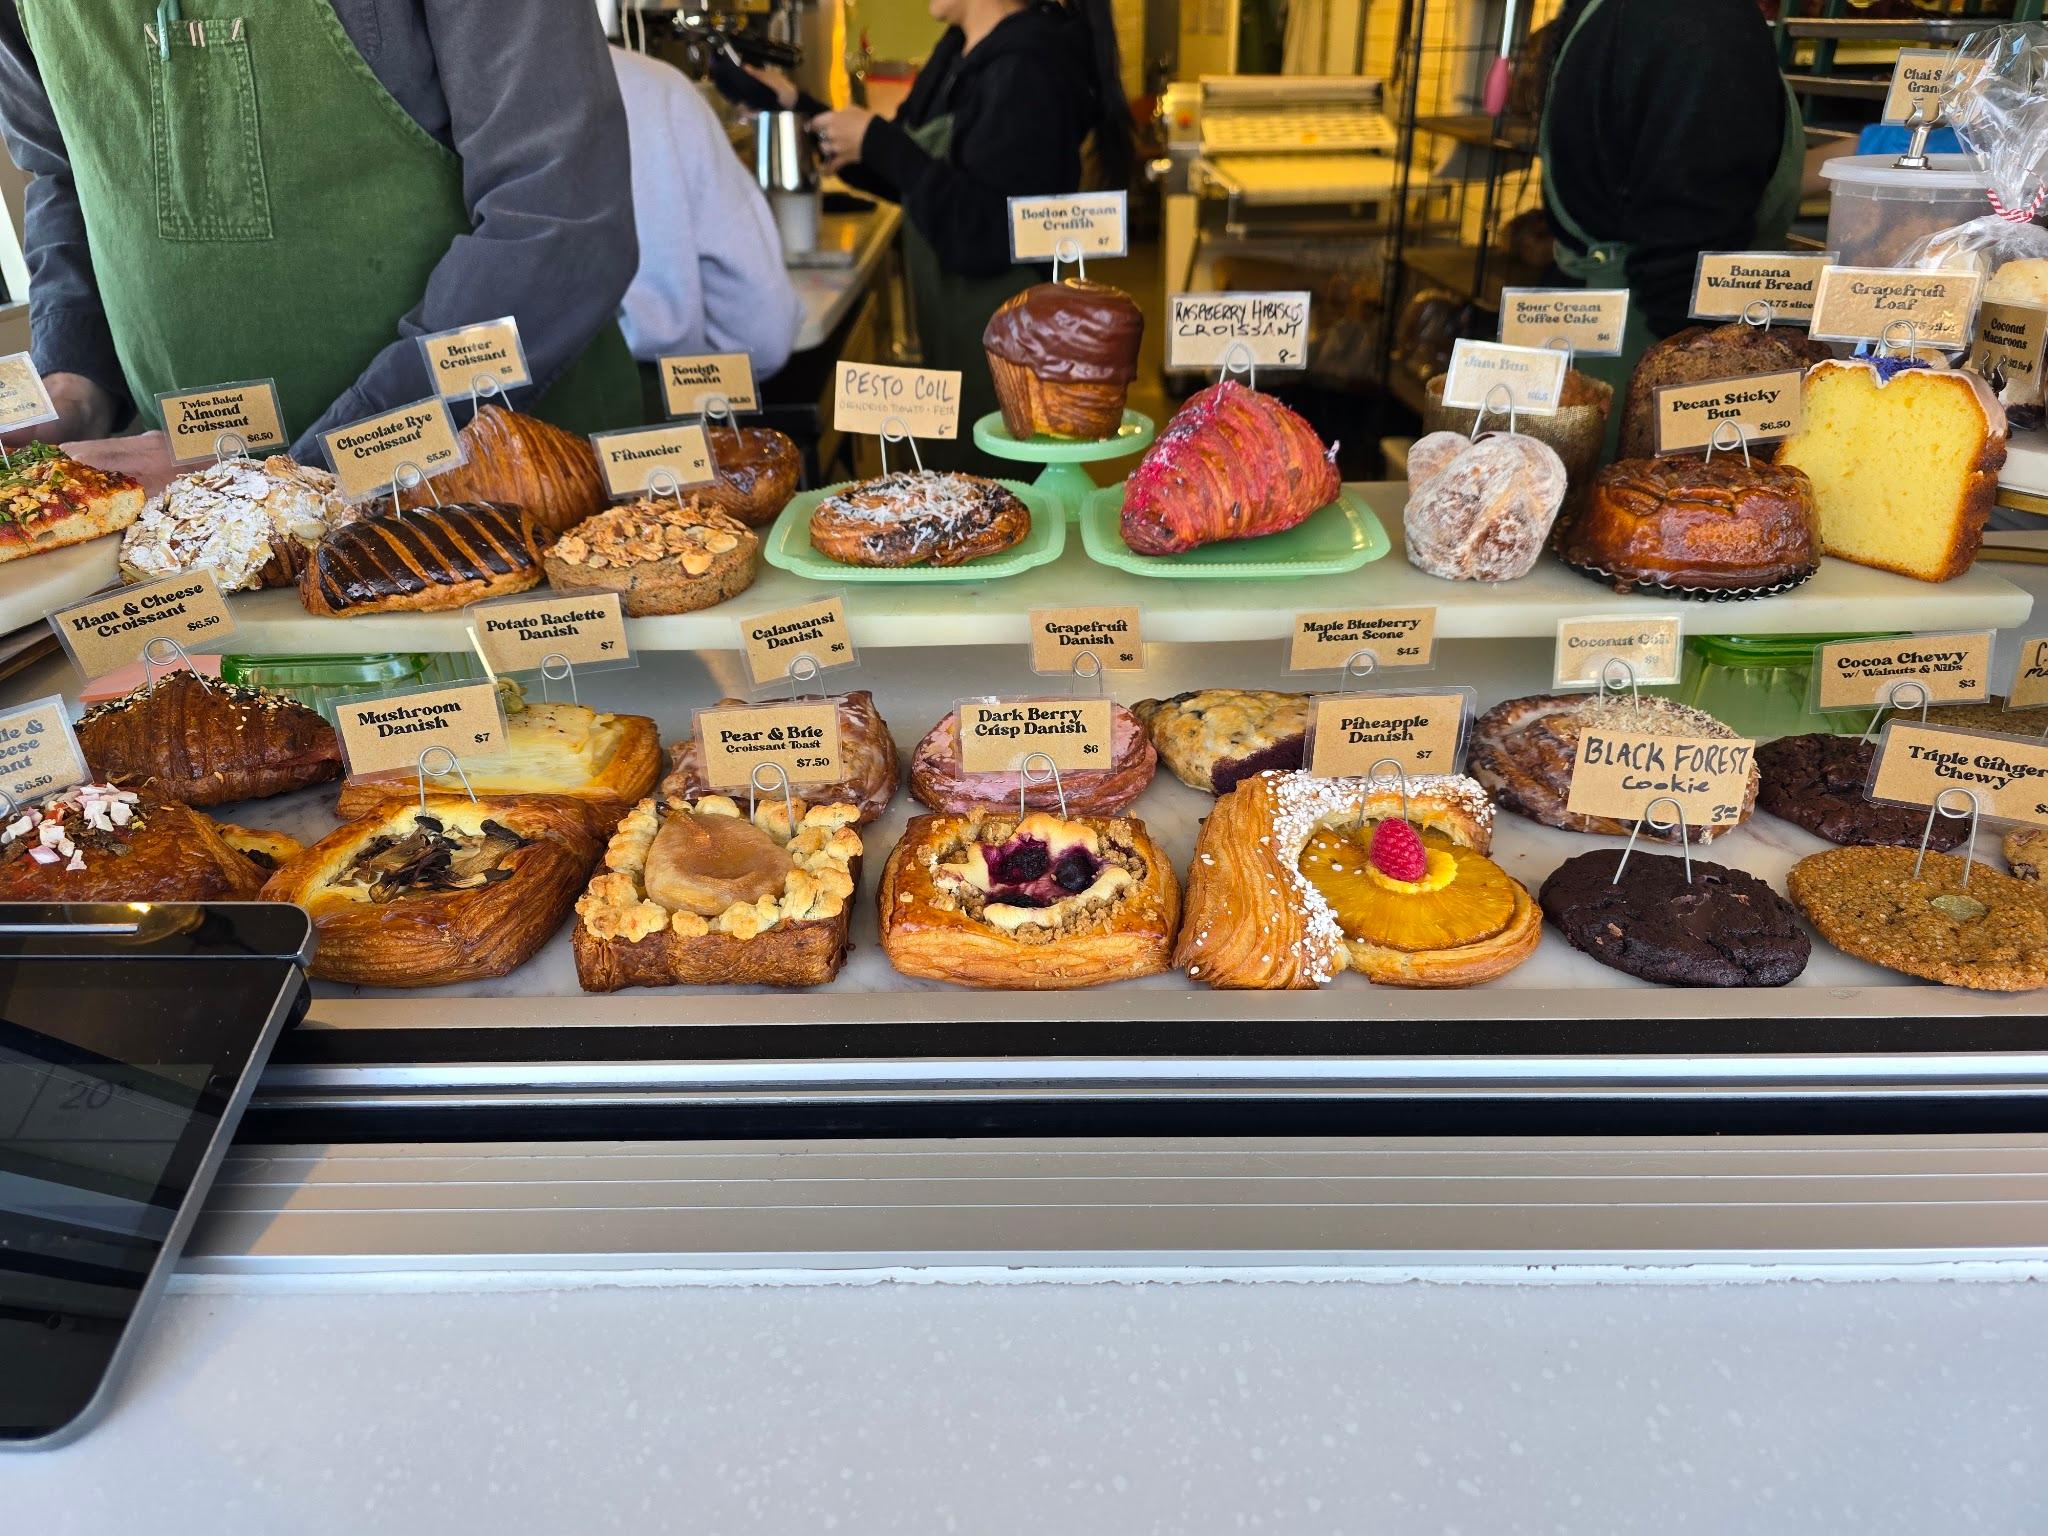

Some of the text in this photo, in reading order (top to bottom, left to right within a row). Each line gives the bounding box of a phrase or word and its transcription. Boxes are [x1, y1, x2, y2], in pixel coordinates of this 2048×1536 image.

[1904, 68, 1932, 80] Chai
[1908, 81, 1940, 93] Gran
[1022, 205, 1116, 219] Boston Cream
[1730, 265, 1791, 278] Banana
[1707, 276, 1813, 291] Walnut Bread
[1851, 282, 1946, 299] Grapefruit
[1517, 301, 1602, 313] Sour Cream
[1875, 297, 1917, 310] Loaf
[1176, 302, 1247, 325] RASPBERRY
[1517, 313, 1599, 324] Coffee Cake
[1179, 320, 1304, 338] CROISSANT
[1991, 318, 2026, 335] Coconut
[1983, 329, 2028, 350] Macaroons
[448, 341, 493, 357] Butter
[440, 349, 507, 370] Croissant
[672, 376, 722, 387] Amann
[846, 369, 954, 403] PESTO COIL
[179, 394, 244, 411] Twice Baked
[1672, 389, 1781, 413] Pecan Sticky
[183, 404, 241, 422] Almond
[933, 404, 956, 417] FETA
[1707, 408, 1742, 420] Bun
[178, 415, 249, 435] Croissant
[336, 413, 433, 451] Chocolate Rye
[1760, 420, 1791, 431] $6.50
[247, 431, 274, 443] $6.50
[354, 429, 422, 458] Croissant
[426, 449, 452, 464] $5.50
[611, 445, 682, 463] Financier
[72, 584, 205, 632] Ham & Cheese
[98, 602, 187, 638] Croissant
[187, 615, 220, 632] $6.50
[487, 609, 606, 632] Potato Raclette
[752, 611, 835, 641] Calamansi
[1045, 619, 1129, 636] Grapefruit
[1303, 618, 1421, 634] Maple Blueberry
[518, 623, 580, 641] Danish
[767, 627, 824, 650] Danish
[1059, 633, 1115, 646] Danish
[1317, 629, 1405, 643] Pecan Scone
[600, 640, 615, 651] $7
[830, 642, 845, 652] $6
[1568, 636, 1634, 648] Coconut
[1119, 653, 1134, 662] $6
[1837, 651, 1970, 669] Cocoa Chewy
[1841, 663, 1964, 679] w/ Walnuts & Nibs
[1959, 679, 1976, 689] $3
[357, 701, 463, 726] Mushroom
[978, 707, 1083, 724] Dark Berry
[377, 715, 450, 738] Danish
[975, 720, 1088, 739] Crisp Danish
[1340, 715, 1430, 733] Pineapple
[475, 732, 491, 743] $7
[720, 725, 824, 743] Pear & Brie
[1349, 730, 1415, 744] Danish
[726, 739, 822, 753] Croissant Toast
[1083, 744, 1098, 754] $6
[1416, 750, 1433, 759] $7
[796, 757, 831, 768] $7.50
[1584, 736, 1752, 776] BLACK FOREST
[1908, 745, 2048, 779] Triple Ginger
[15, 774, 53, 793] $6.50
[1934, 765, 2014, 790] Chewy
